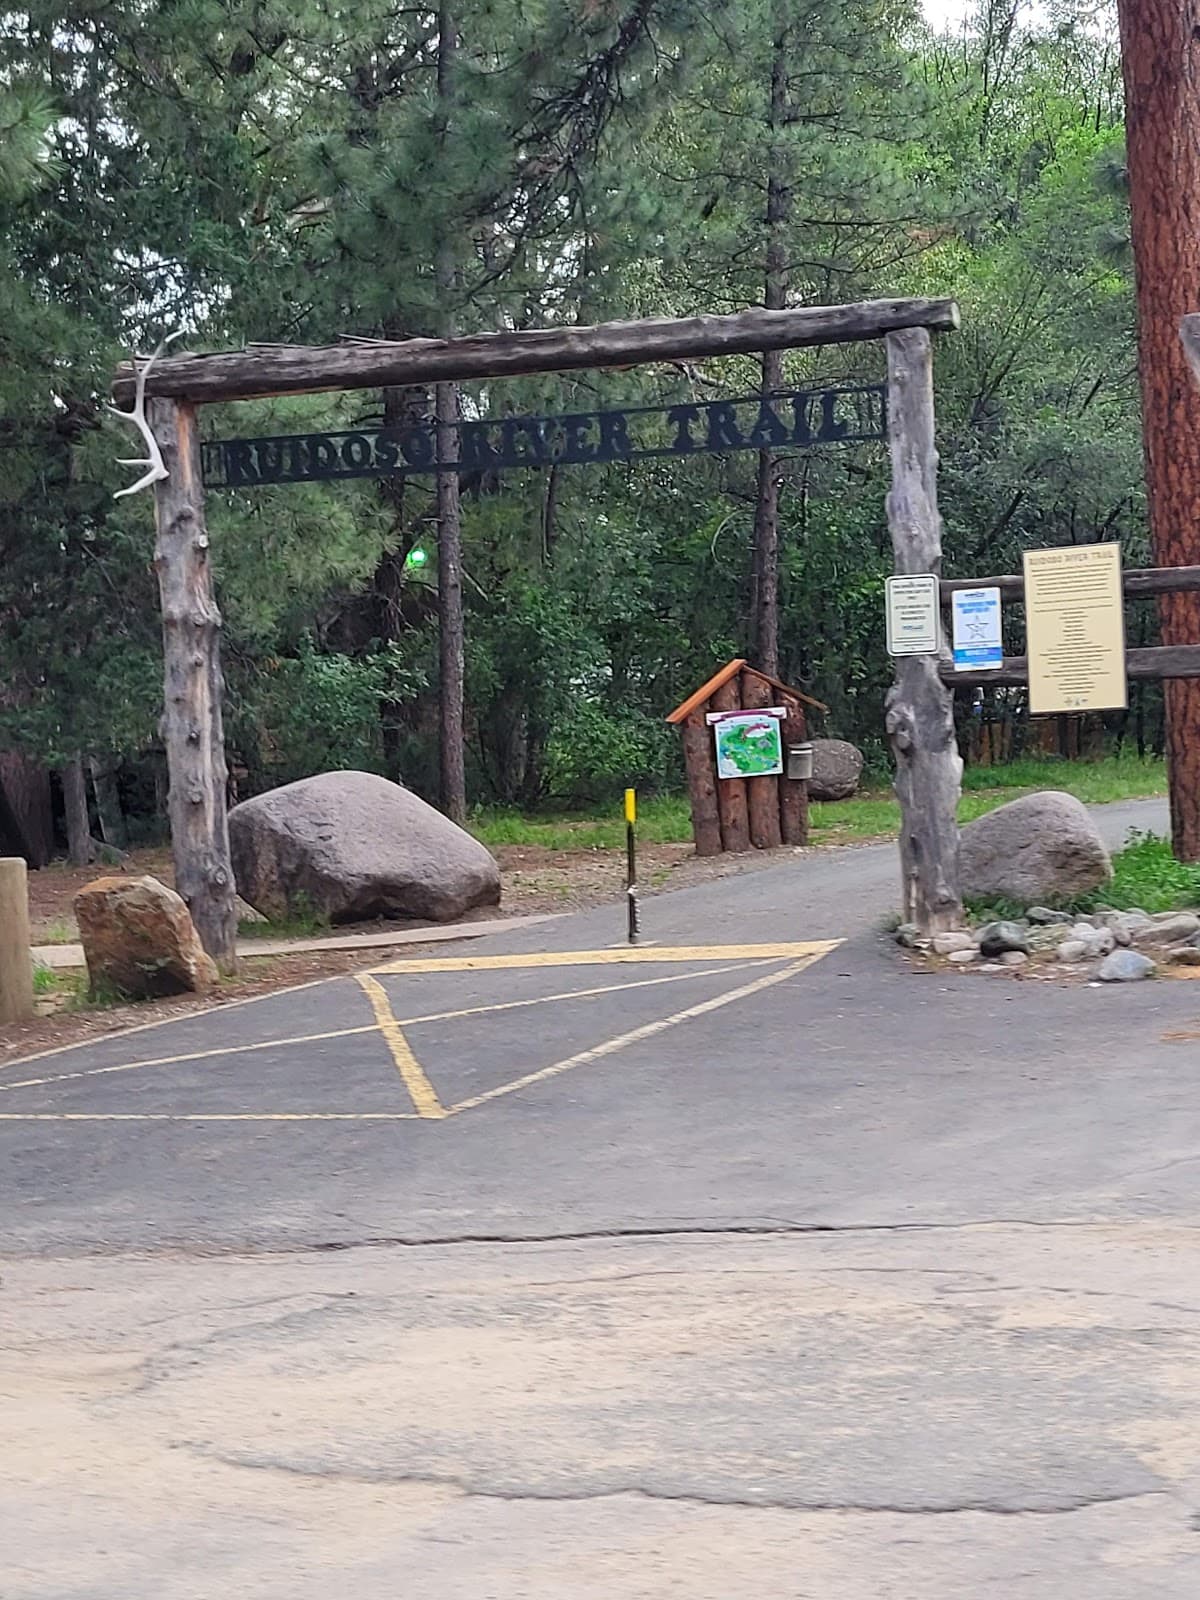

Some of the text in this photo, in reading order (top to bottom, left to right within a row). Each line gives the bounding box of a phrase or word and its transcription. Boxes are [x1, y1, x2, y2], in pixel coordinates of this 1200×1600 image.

[228, 391, 846, 481] RUIDOSO RIVER TRAIL
